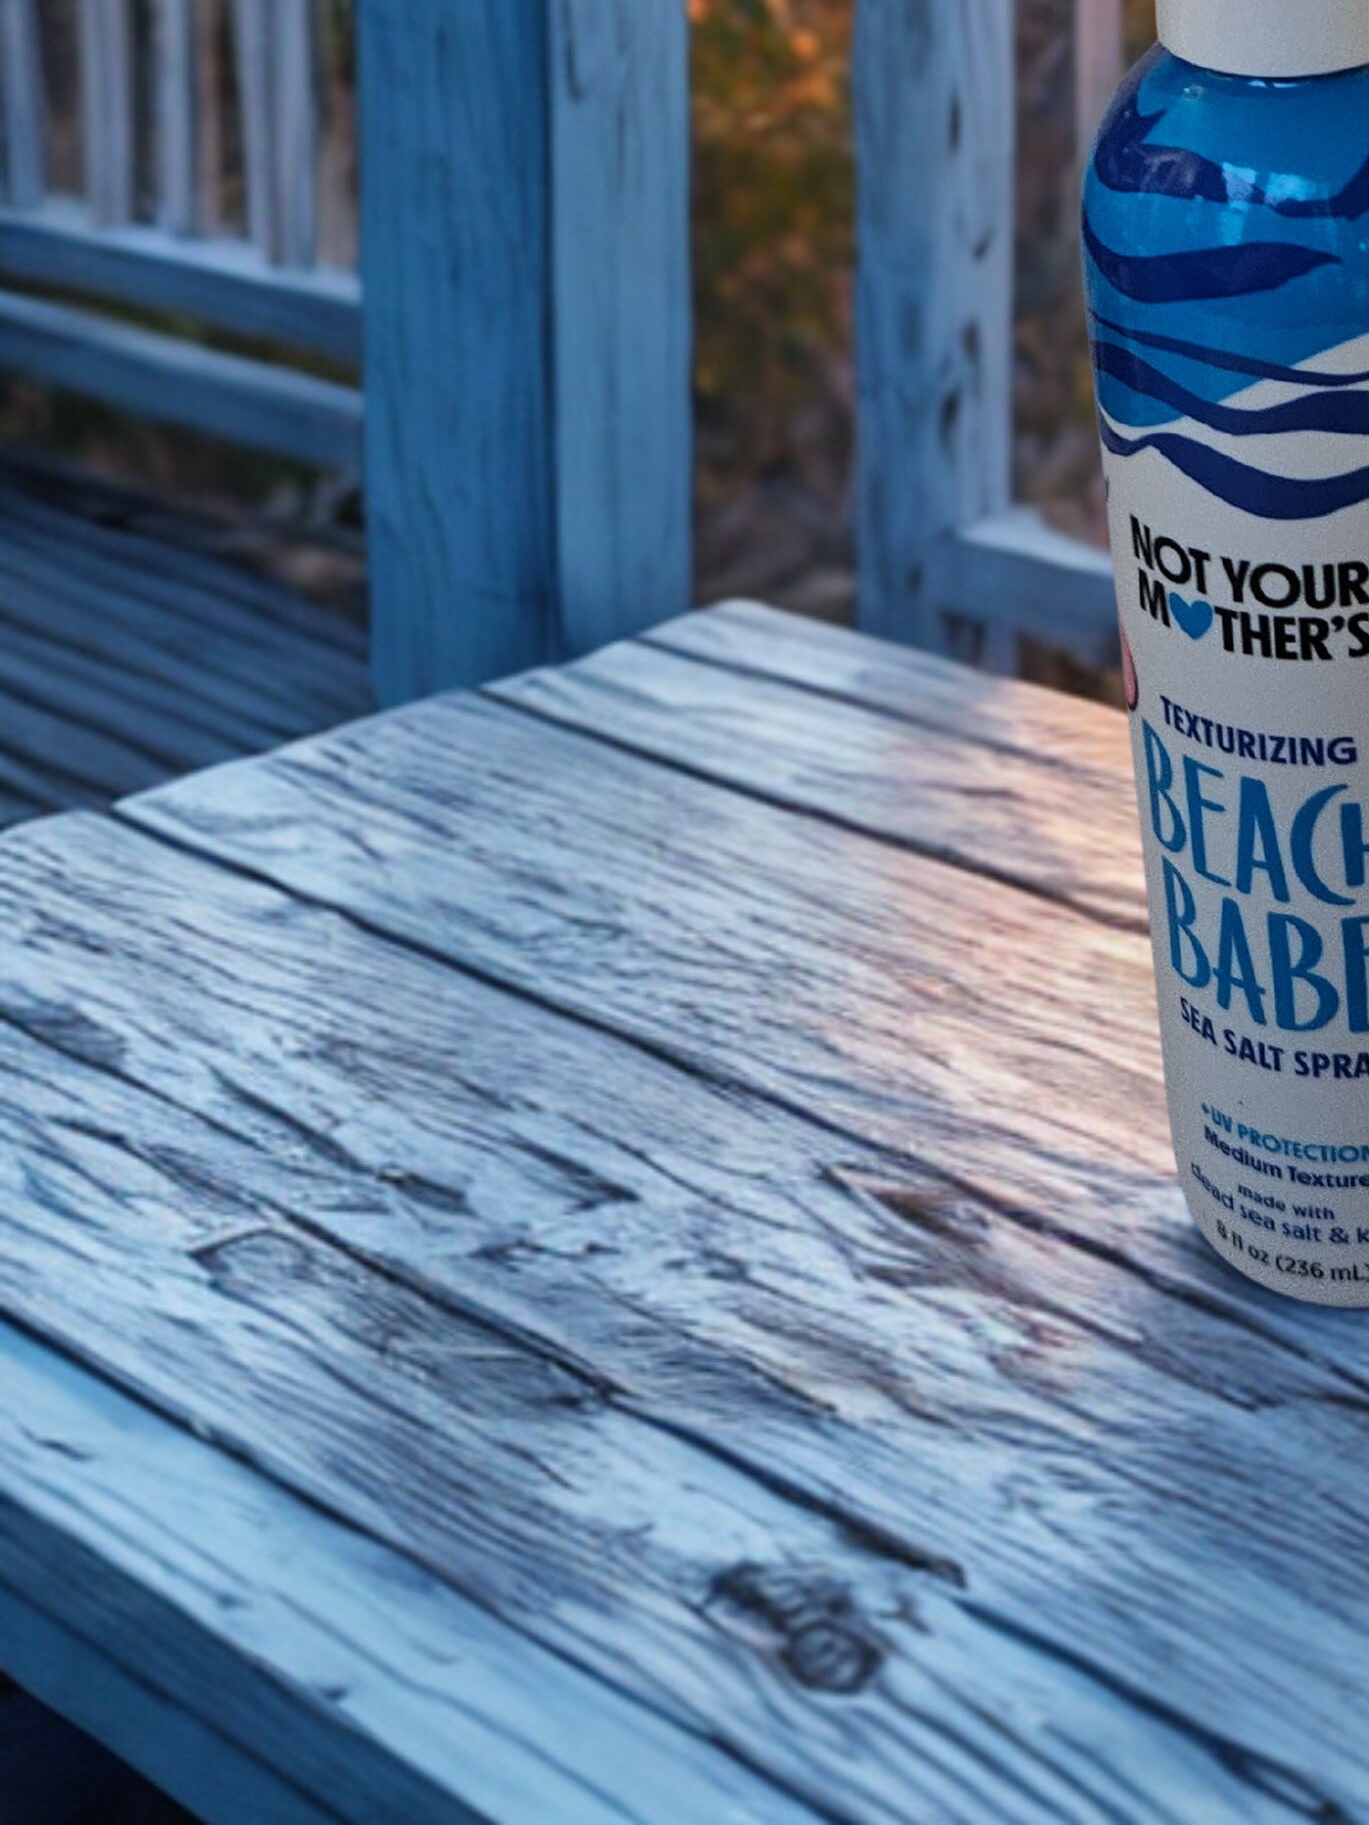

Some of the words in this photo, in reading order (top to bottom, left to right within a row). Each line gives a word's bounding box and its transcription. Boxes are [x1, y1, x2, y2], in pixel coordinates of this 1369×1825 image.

[1131, 514, 1211, 594] NOT
[1159, 694, 1358, 766] TEXTURIZING
[1179, 996, 1218, 1048] SEA
[1224, 1029, 1285, 1072] SALT
[1204, 1125, 1282, 1179] Medium
[1191, 1162, 1234, 1210] dead
[1240, 1204, 1275, 1231] sea
[1282, 1223, 1321, 1243] salt
[1328, 1227, 1350, 1245] &
[1238, 1184, 1286, 1211] made
[1292, 1203, 1335, 1221] with
[1216, 1220, 1229, 1241] 8
[1231, 1230, 1243, 1251] fl
[1248, 1245, 1270, 1266] oz
[1275, 1254, 1325, 1279] (236
